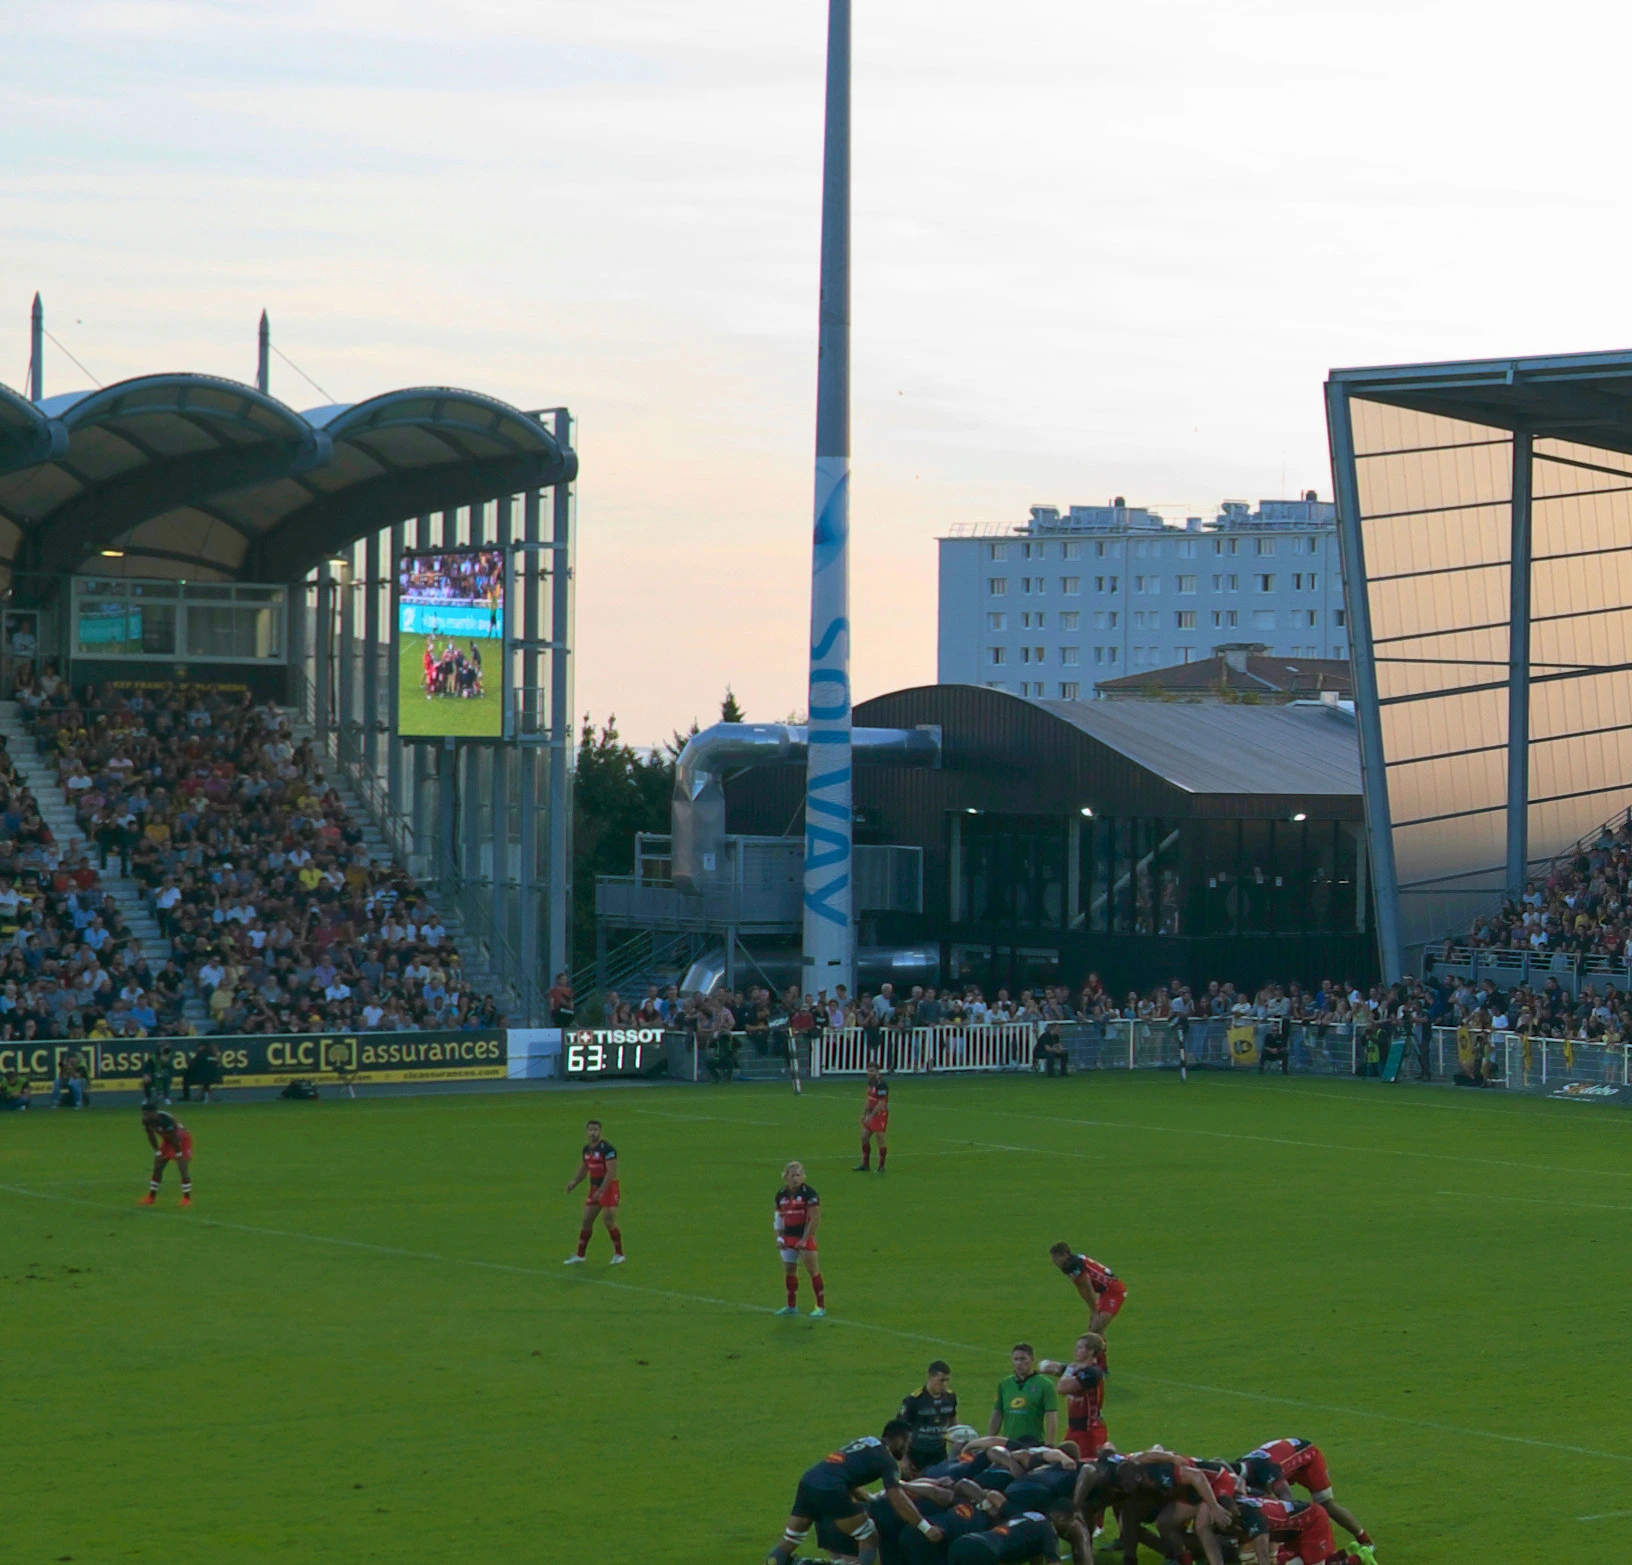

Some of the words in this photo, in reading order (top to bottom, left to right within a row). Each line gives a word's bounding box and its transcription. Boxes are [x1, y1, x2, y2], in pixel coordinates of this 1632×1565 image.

[593, 1028, 665, 1044] TISSOT
[0, 1049, 49, 1073] CLC
[266, 1041, 315, 1066] CLC
[362, 1040, 500, 1064] assurances
[567, 1044, 642, 1072] 63:11
